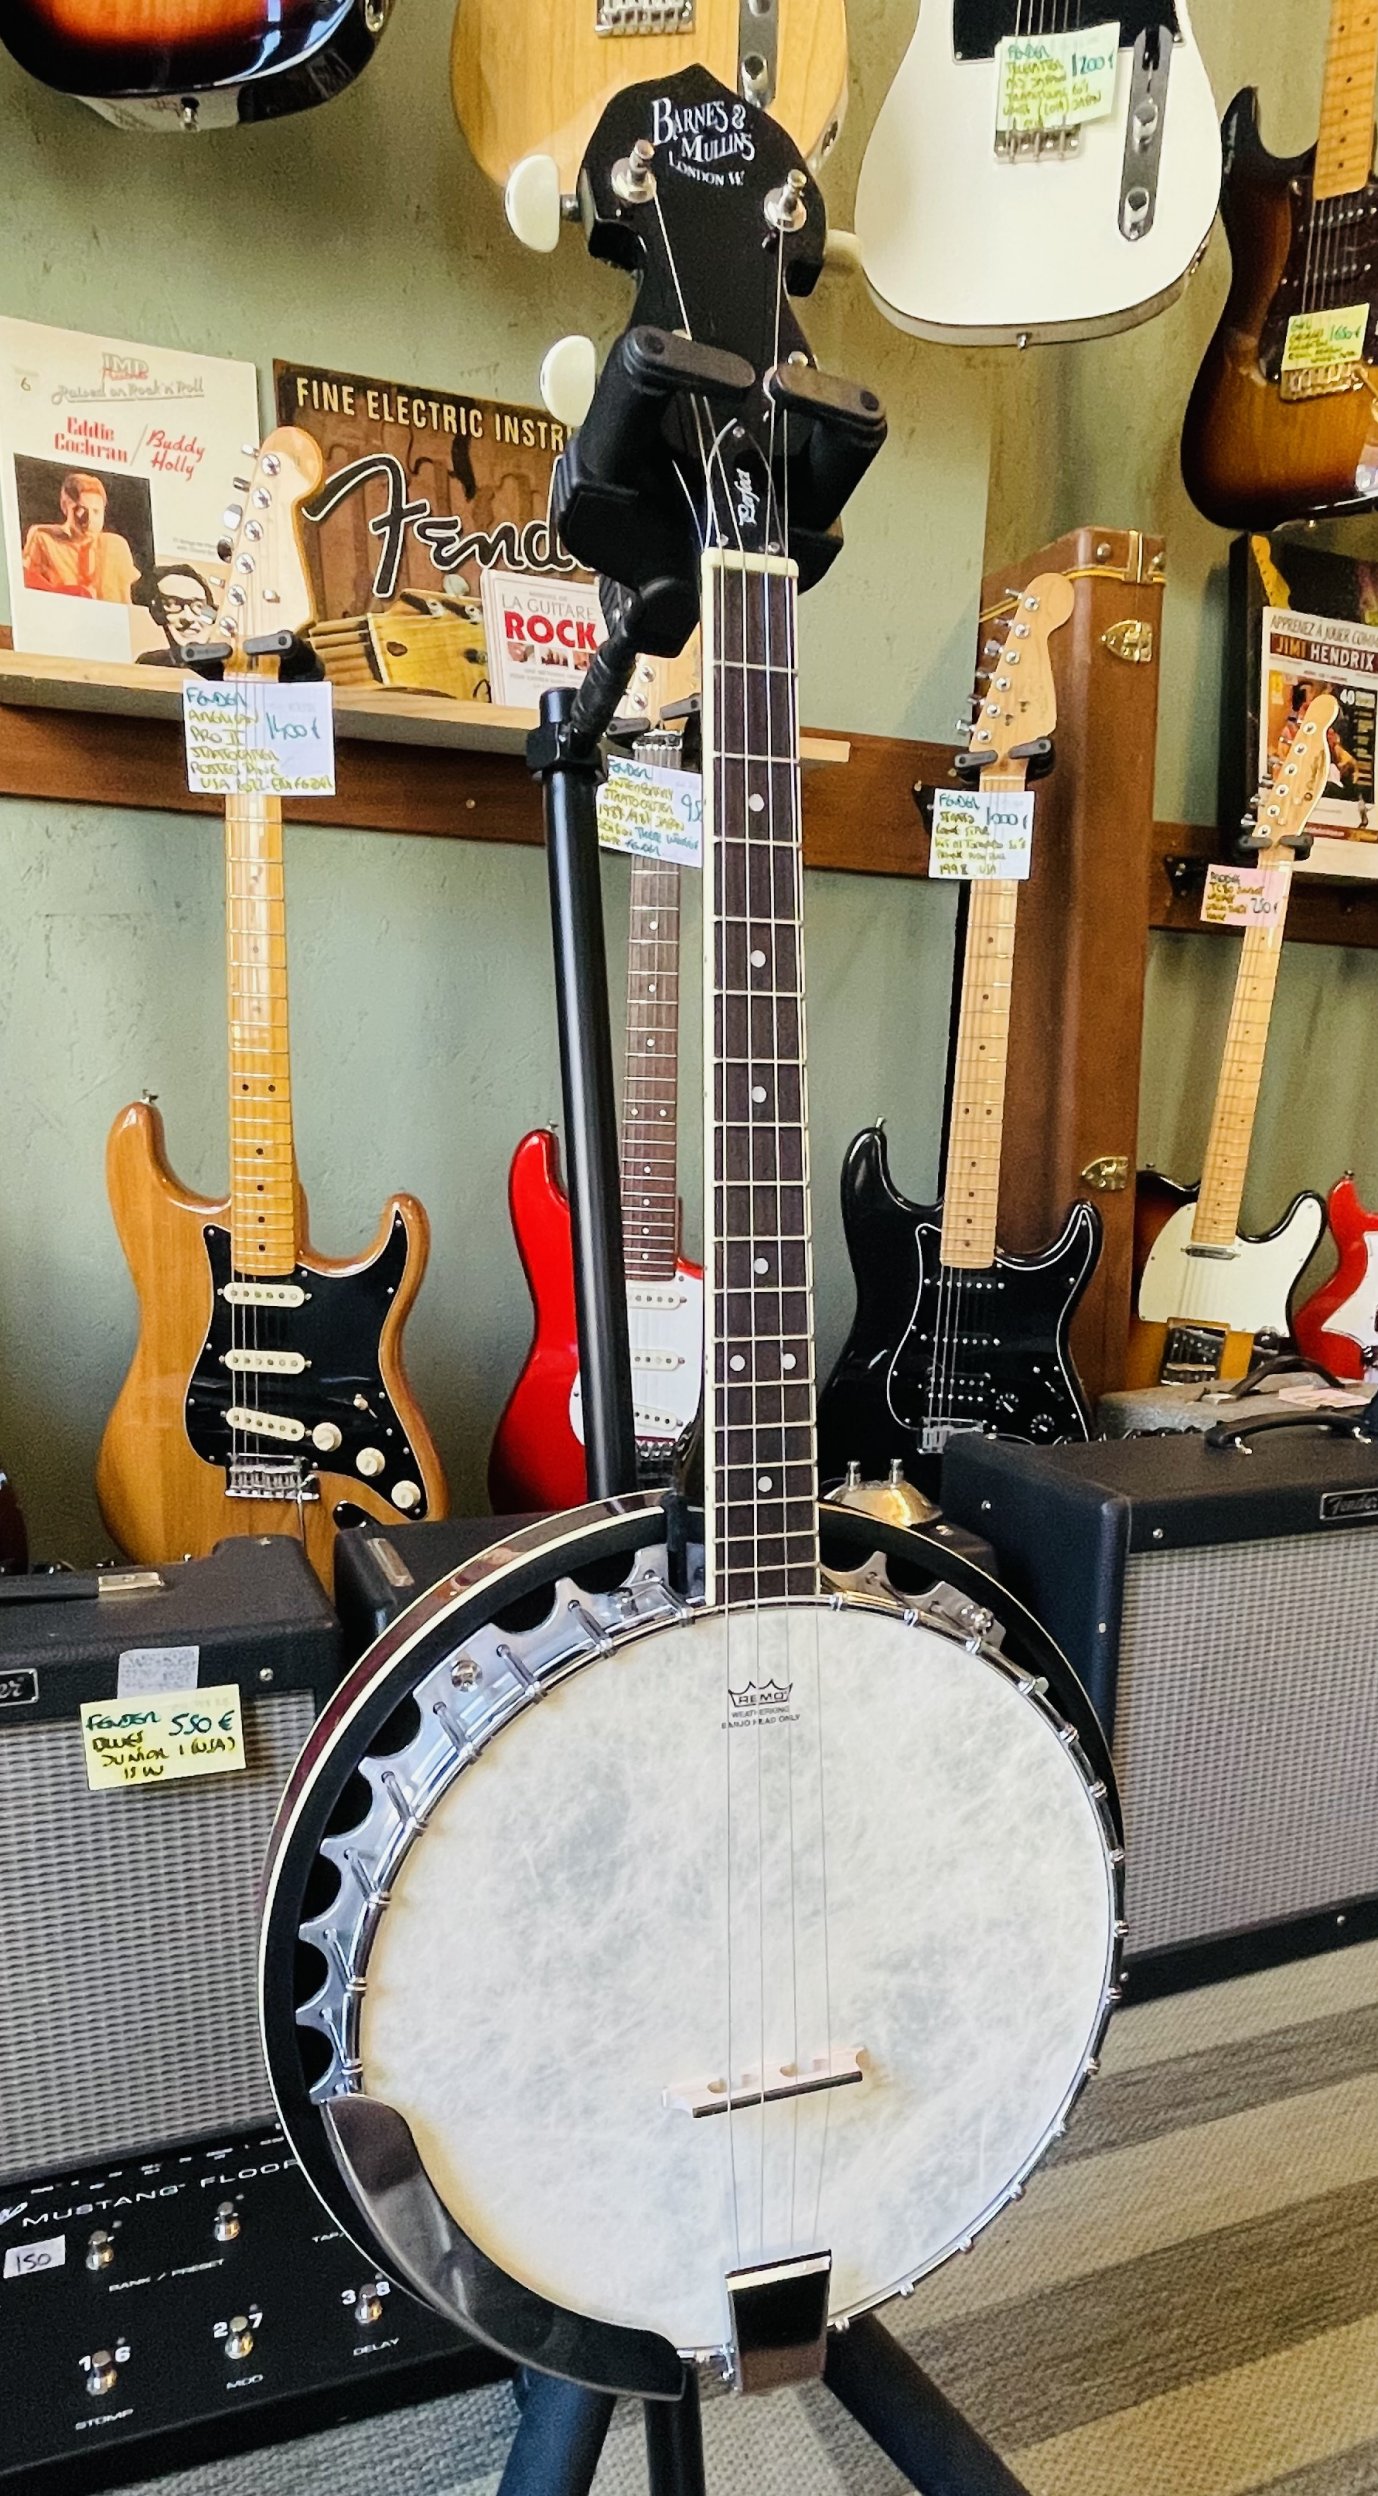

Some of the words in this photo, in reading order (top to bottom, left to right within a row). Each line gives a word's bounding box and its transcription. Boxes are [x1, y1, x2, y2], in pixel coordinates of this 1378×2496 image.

[1072, 53, 1105, 77] 1200
[652, 97, 728, 146] BARNES
[731, 103, 746, 130] &
[681, 132, 755, 162] MULLINS
[668, 150, 724, 186] LONDON
[21, 377, 31, 391] 6
[296, 377, 355, 416] FINE
[367, 390, 483, 438] ELECTRIC
[495, 413, 576, 451] INSTR
[67, 416, 114, 441] Eddie
[54, 433, 128, 463] Cochran
[146, 429, 205, 462] Buddy
[151, 451, 195, 481] Holly
[301, 453, 600, 598] Fend
[502, 593, 523, 611] LA
[527, 598, 597, 621] GUITARE
[504, 611, 599, 652] ROCK
[1270, 614, 1315, 637] APPRENEZ
[1323, 626, 1351, 643] JOUER
[1275, 635, 1308, 659] JIMI
[1310, 642, 1375, 673] HENDRIX
[186, 686, 248, 708] FENDER
[1340, 688, 1356, 706] 40
[190, 725, 222, 744] PRO
[939, 793, 981, 810] FENDER
[738, 1692, 785, 1703] REMO
[86, 1711, 162, 1731] FENDER
[168, 1712, 212, 1736] 550
[218, 1710, 235, 1731] €
[778, 1714, 801, 1723] ONLY
[22, 2184, 180, 2227] MUSTANG
[16, 2250, 52, 2275] 150
[108, 2276, 151, 2292] BANK
[171, 2257, 226, 2277] PRESET
[341, 2289, 357, 2305] 3
[375, 2282, 391, 2297] 8
[212, 2321, 229, 2338] 2
[248, 2312, 264, 2328] 7
[114, 2346, 132, 2362] 6
[352, 2337, 400, 2357] DELAY
[78, 2354, 93, 2371] 1
[226, 2373, 264, 2390] MOD
[75, 2408, 134, 2431] STOMP
